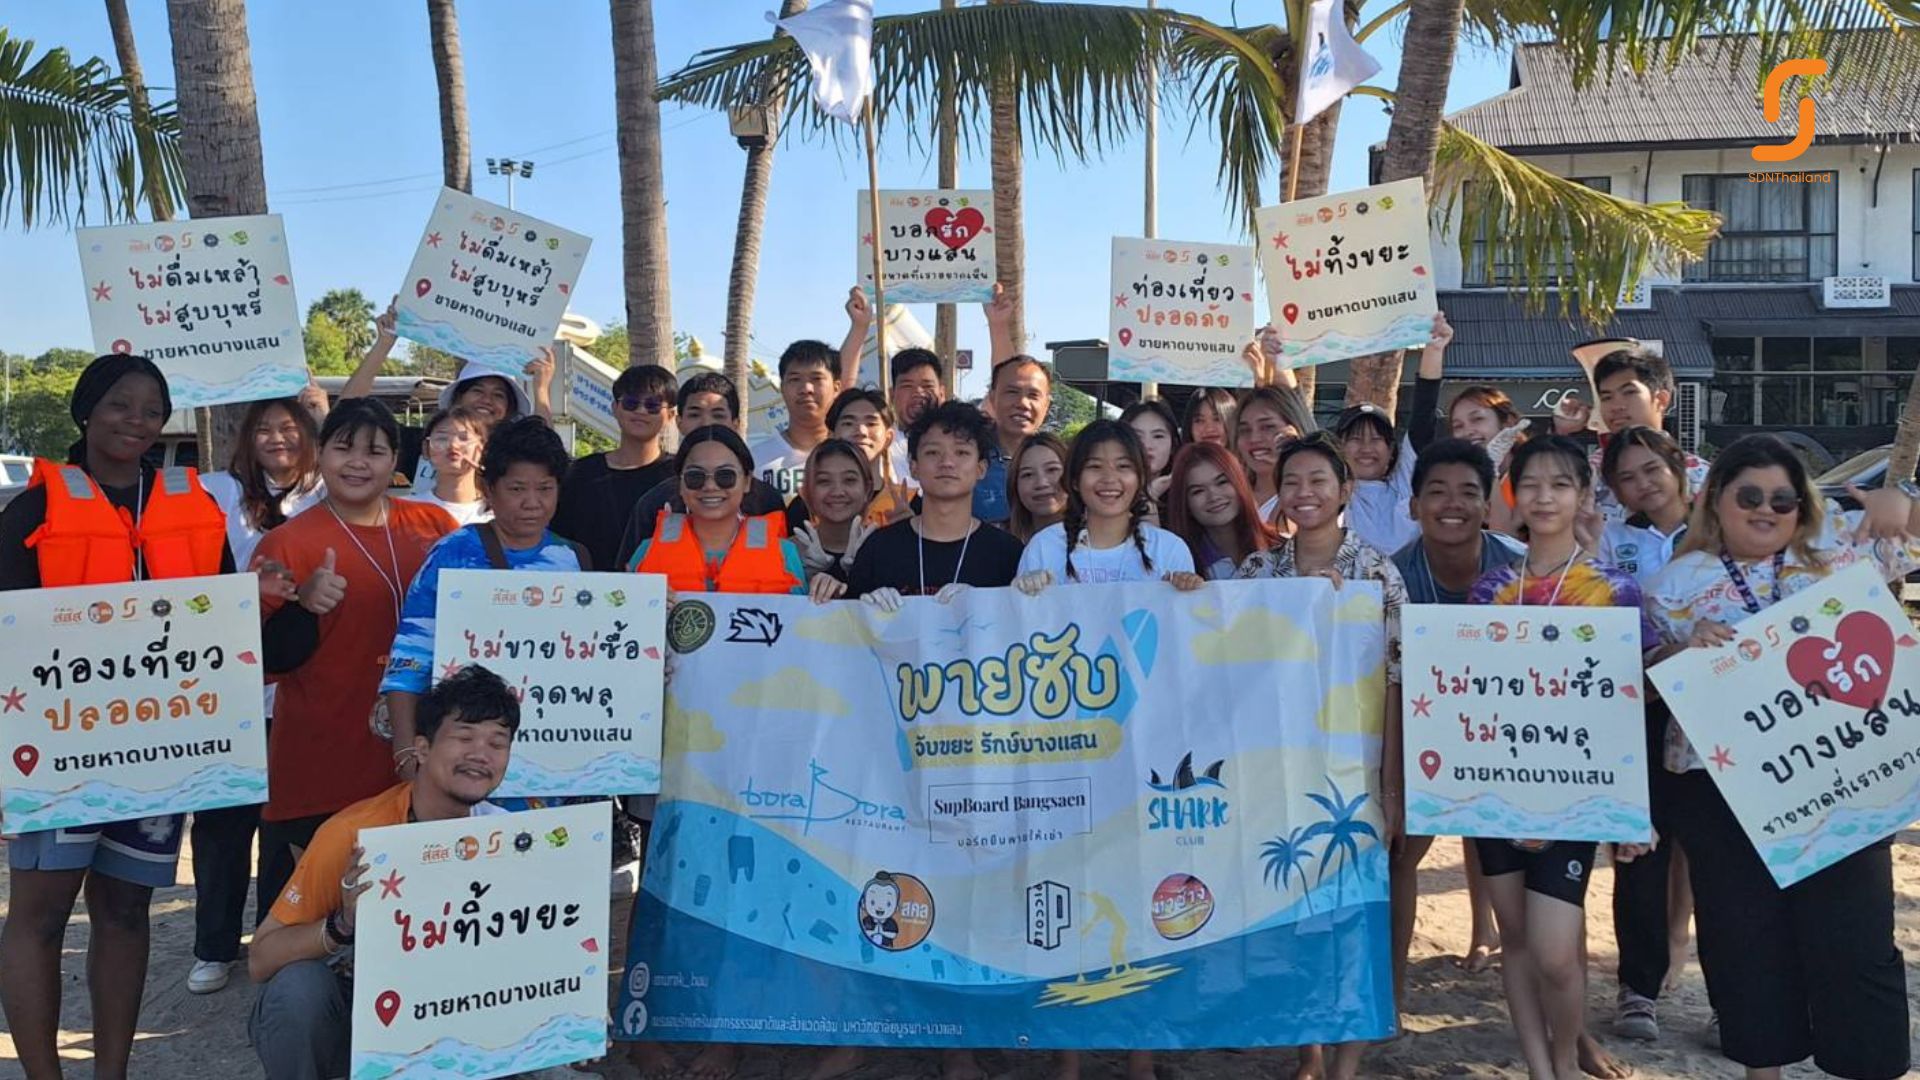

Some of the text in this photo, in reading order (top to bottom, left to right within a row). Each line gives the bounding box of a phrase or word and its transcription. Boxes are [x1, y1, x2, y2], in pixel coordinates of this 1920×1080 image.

[129, 254, 260, 290] ไม่ดื่มเหล้า
[1285, 235, 1410, 280] ไม่ทิ้งขยะ
[1132, 267, 1235, 302] ท่องเที่ยว
[435, 293, 537, 338] ชายหาดบางแสน
[1136, 303, 1230, 329] ปลอดภัย
[1307, 290, 1418, 321] ชายหาดบางแสน
[1139, 338, 1235, 354] ชายหาดบางแสน
[32, 621, 224, 690] ท่องเที่ยว
[465, 620, 639, 660] ไม่ขายไม่ซื้อ
[897, 623, 1120, 721] พายซับ
[1431, 656, 1614, 699] ไม่ขายไม่ซื้อ
[44, 678, 219, 731] ปลอดภัย
[506, 675, 613, 719] ม่จุดพลุ
[914, 731, 1097, 757] จับขยะ รักษ์บางแสน
[1459, 712, 1591, 760] ไม่จุดพลุ
[54, 739, 232, 772] ชายหาดบางแสน
[1454, 766, 1614, 785] ชายหาดบางแสน
[934, 793, 1086, 817] SupBoard Bangsaen
[1148, 796, 1230, 830] SHARK
[1176, 836, 1204, 846] CLUB
[394, 881, 580, 951] ไม่ทิ้งขยะ
[414, 976, 581, 1020] ชายหาดบางแสน
